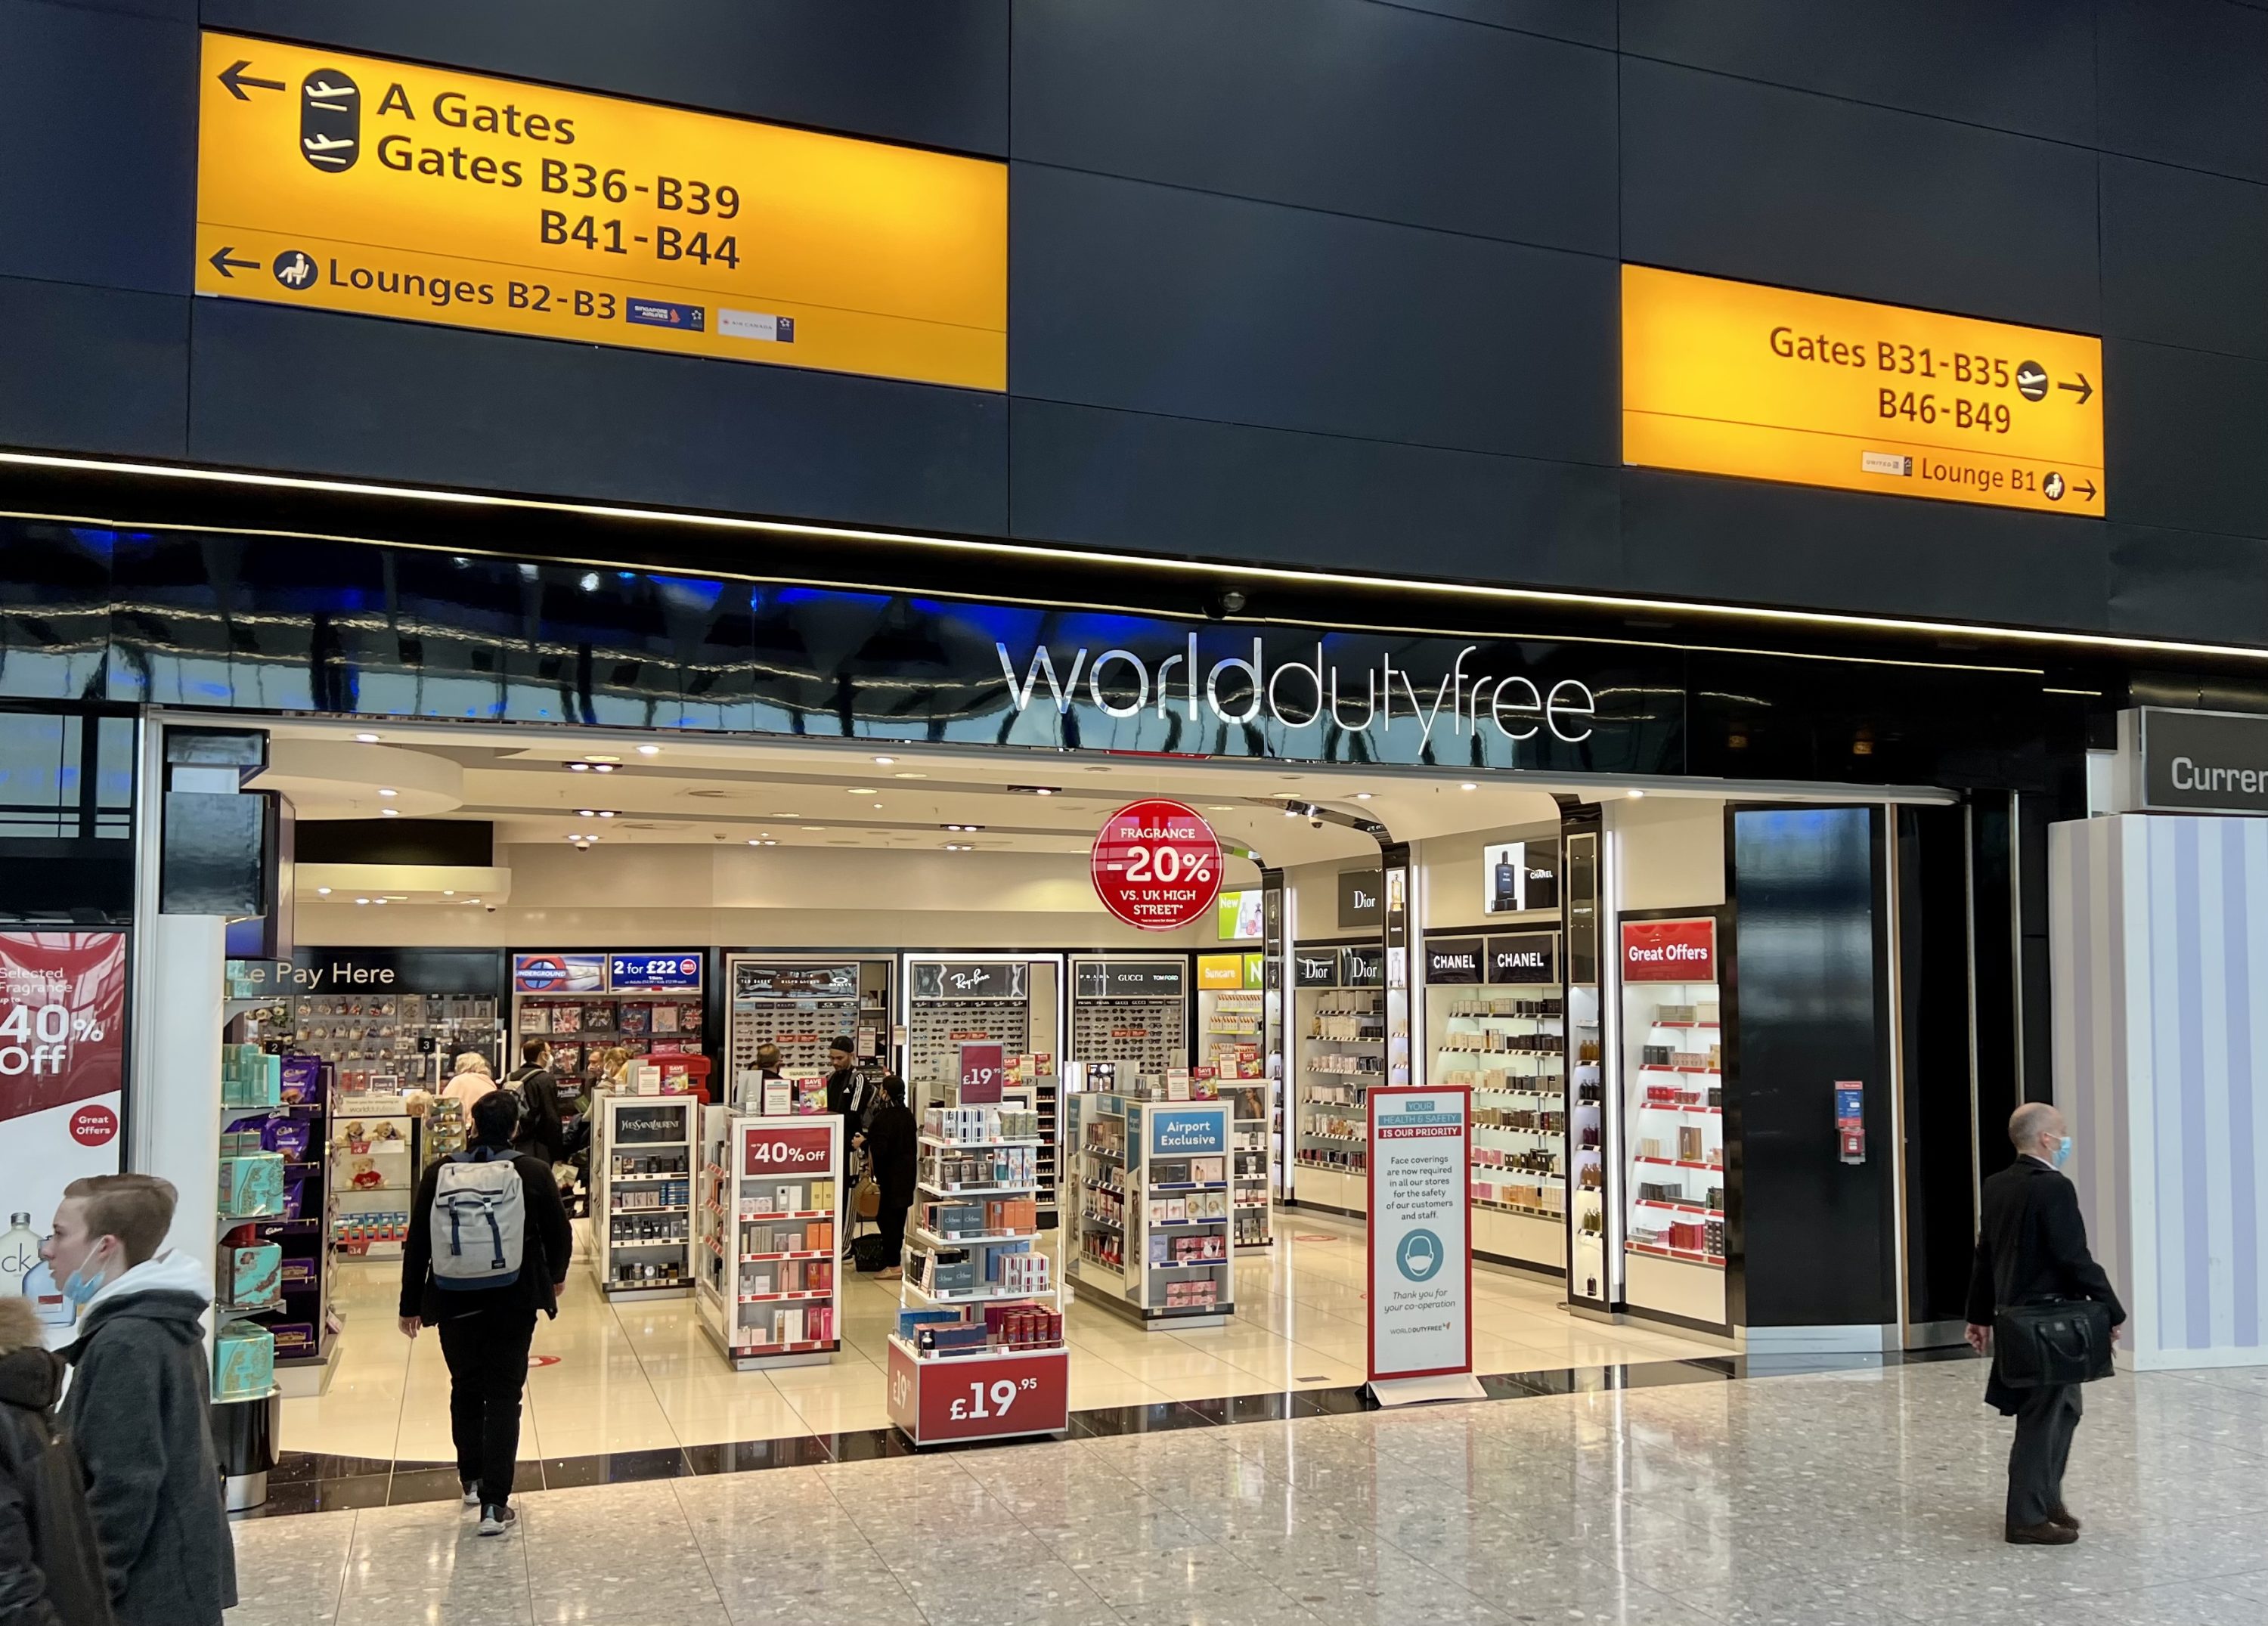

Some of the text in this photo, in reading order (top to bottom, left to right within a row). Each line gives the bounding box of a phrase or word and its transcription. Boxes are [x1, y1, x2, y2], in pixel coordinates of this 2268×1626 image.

[377, 83, 576, 145] A Gates
[377, 135, 741, 220] Gates B36-B39
[541, 208, 741, 271] B41-B44
[329, 258, 617, 321] Lounges B2-B3
[634, 305, 669, 314] SINGAPORE
[642, 311, 669, 320] AIRLINES
[1770, 326, 2009, 389] Gates B31-B35
[1879, 388, 2012, 434] B46-B49
[1922, 457, 2036, 492] Lounge B1
[1120, 828, 1196, 839] FRAGRANCE
[1107, 845, 1210, 883] -20%
[1529, 870, 1553, 880] CHANEL
[1120, 890, 1196, 901] VS. UK HIGH
[1353, 890, 1376, 909] Dior
[1219, 897, 1239, 909] New
[1628, 943, 1709, 962] Great Offers
[614, 961, 624, 974] 2
[627, 961, 644, 974] for
[646, 960, 677, 974] £22
[1352, 956, 1377, 977] Dior
[1433, 954, 1476, 970] CHANEL
[1497, 952, 1545, 968] CHANEL
[0, 968, 64, 979] Selected
[276, 962, 323, 990] Pay
[333, 962, 395, 983] Here
[1205, 968, 1235, 978] Suncare
[1305, 959, 1328, 979] Dior
[0, 1004, 104, 1044] 40%
[271, 1044, 278, 1052] 2
[423, 1041, 429, 1049] 3
[0, 1045, 67, 1075] Off
[1408, 1102, 1433, 1110] YOUR
[79, 1116, 109, 1124] Great
[1383, 1113, 1457, 1124] HEALTH & SAFETY
[76, 1126, 110, 1135] Offers
[1167, 1121, 1211, 1135] Airport
[1383, 1127, 1458, 1138] IS OUR PRIORITY
[1161, 1134, 1216, 1147] Exclusive
[754, 1141, 826, 1163] 40% Off
[1391, 1155, 1448, 1166] Face coverings
[1420, 1166, 1452, 1176] required
[1421, 1188, 1446, 1198] safety
[1411, 1200, 1453, 1209] customers
[1401, 1211, 1438, 1220] and staff.
[2, 1243, 32, 1272] ck
[1393, 1288, 1448, 1300] Thank you for
[1384, 1300, 1455, 1314] your co-operation
[950, 1377, 1037, 1420] £19.95
